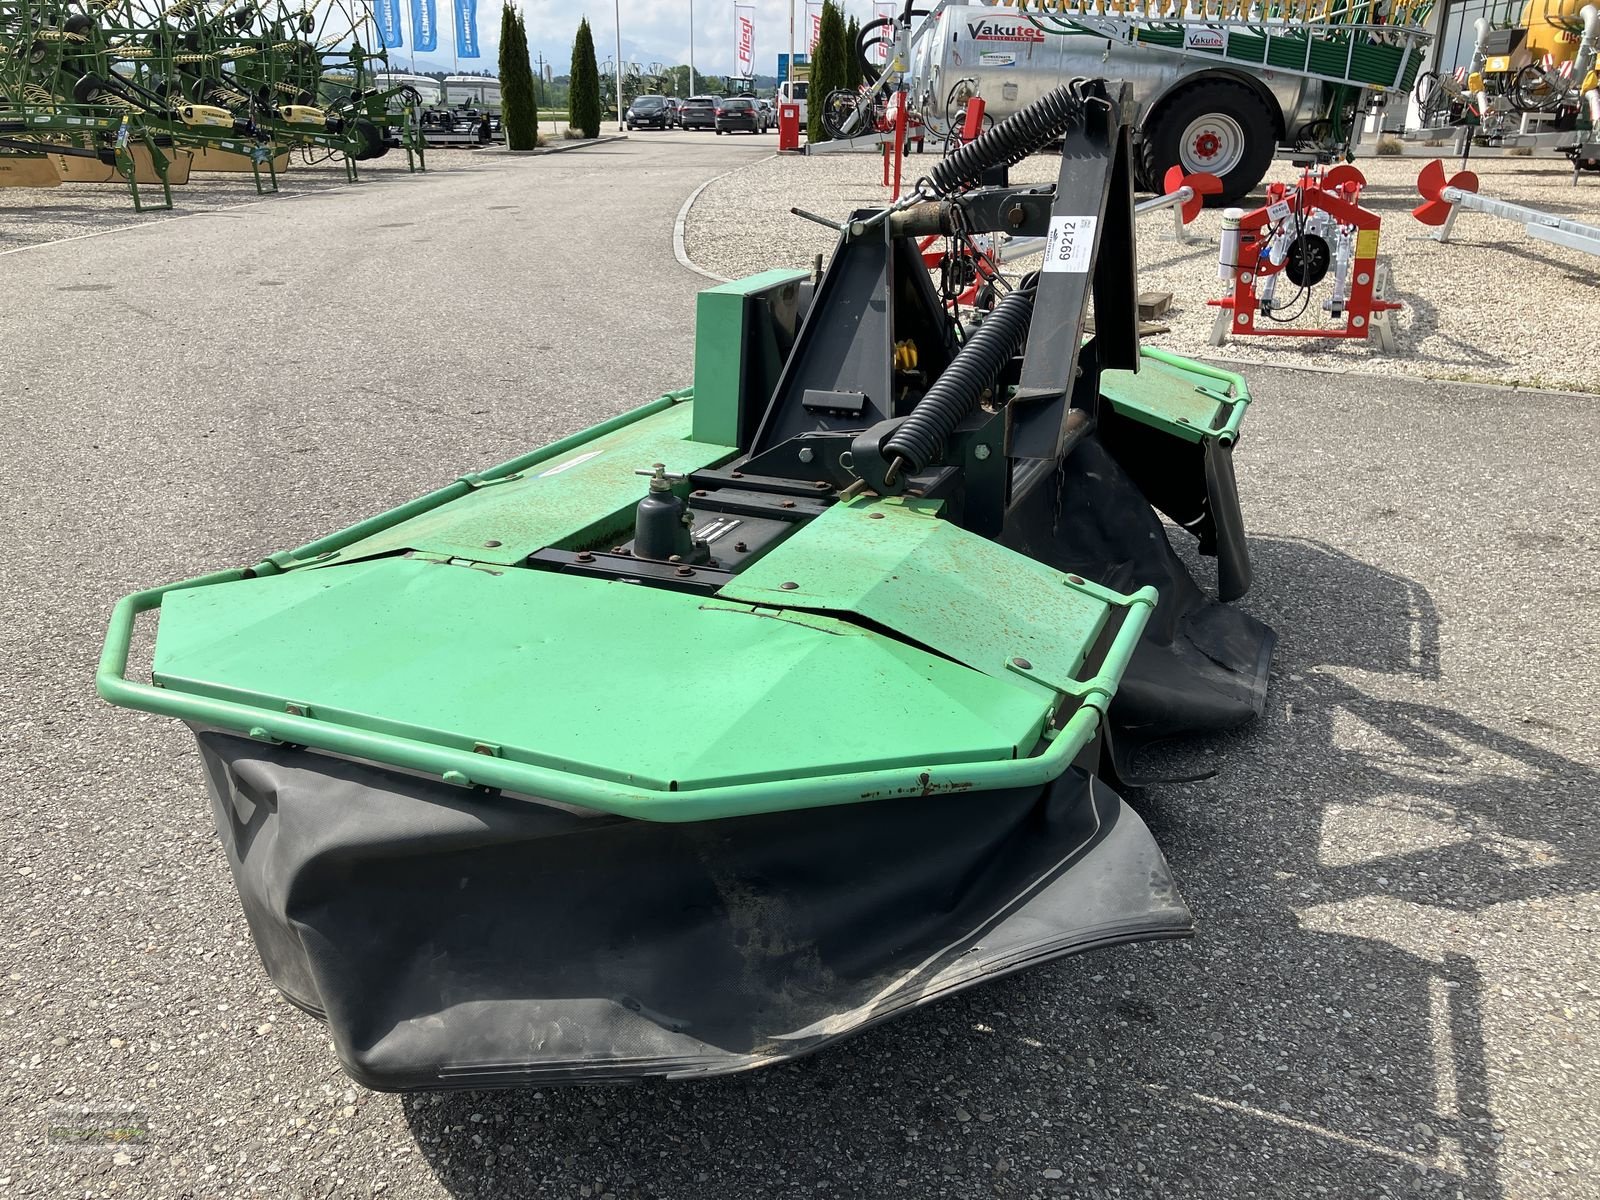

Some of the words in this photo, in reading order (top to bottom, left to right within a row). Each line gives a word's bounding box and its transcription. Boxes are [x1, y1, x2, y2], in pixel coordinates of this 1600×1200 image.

[739, 17, 753, 63] Fliegl
[967, 20, 1045, 40] Vakutec
[1188, 34, 1224, 46] Vakutec
[1059, 222, 1076, 261] 69212
